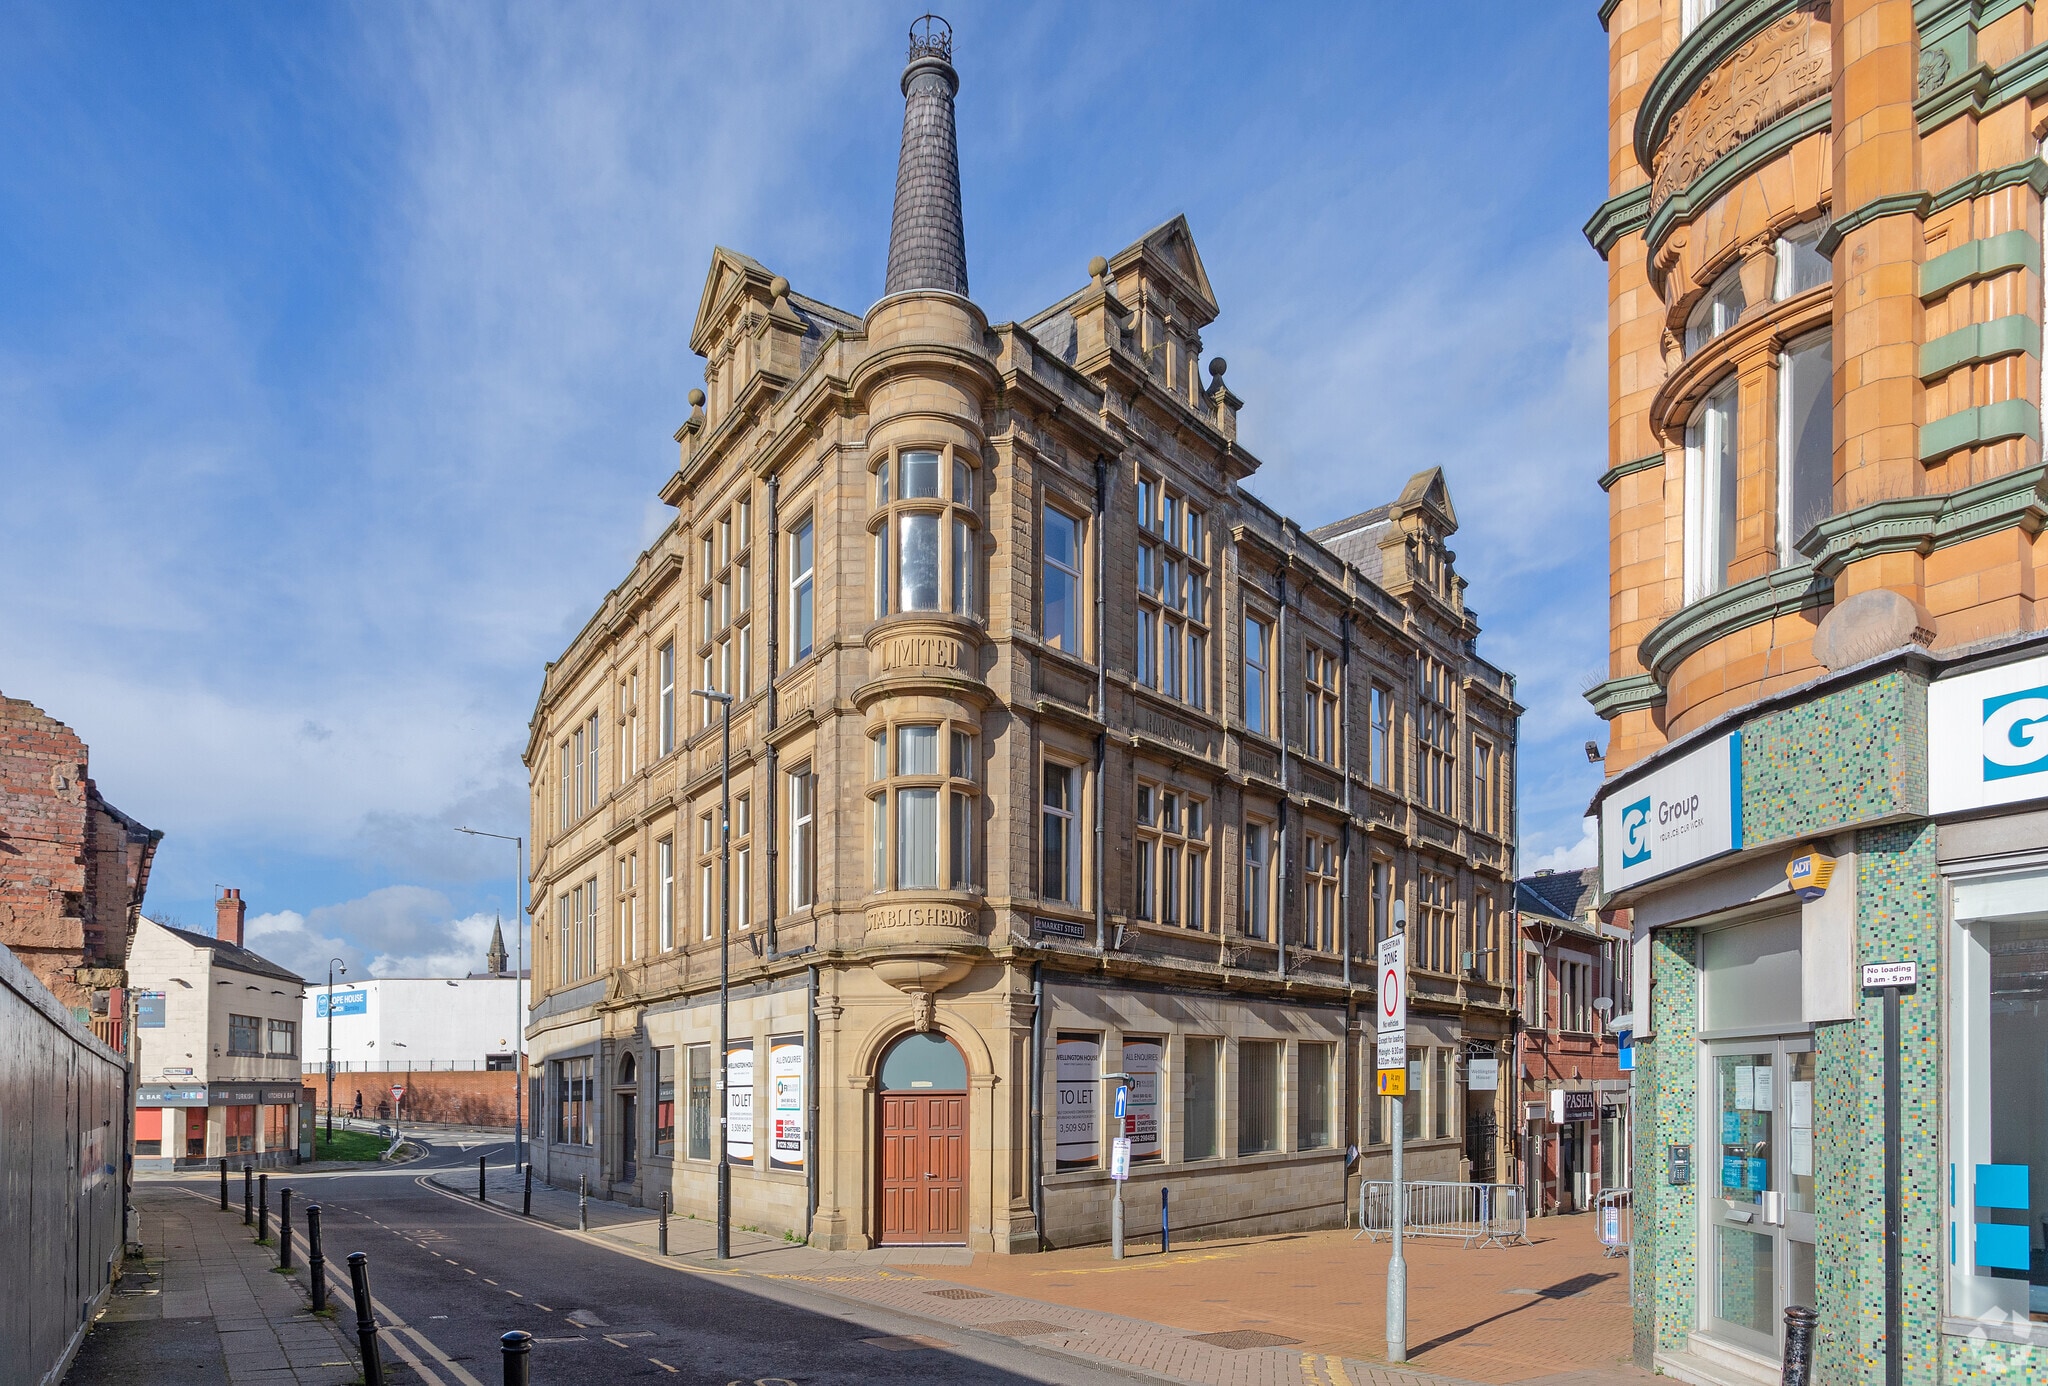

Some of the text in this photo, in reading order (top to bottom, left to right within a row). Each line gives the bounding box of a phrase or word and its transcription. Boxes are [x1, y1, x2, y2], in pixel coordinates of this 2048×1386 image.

[881, 638, 958, 671] LIMITED
[1658, 794, 1699, 825] Group
[1793, 860, 1810, 875] ADT
[866, 908, 957, 932] STABLISHED
[1041, 920, 1084, 935] MARKET STREET
[1381, 939, 1401, 952] PEDESTRIAN
[1384, 950, 1398, 966] ZONE
[1881, 965, 1912, 974] loading
[1866, 976, 1872, 984] 8
[332, 993, 364, 1004] OPE HOUSE
[1126, 1053, 1158, 1061] ALL ENQUIRIES
[731, 1093, 752, 1107] TO LET
[1060, 1089, 1094, 1104] TO LET
[1566, 1093, 1593, 1109] PASHA
[731, 1124, 741, 1132] 3,509
[1060, 1122, 1094, 1133] 3,509 SQ FT
